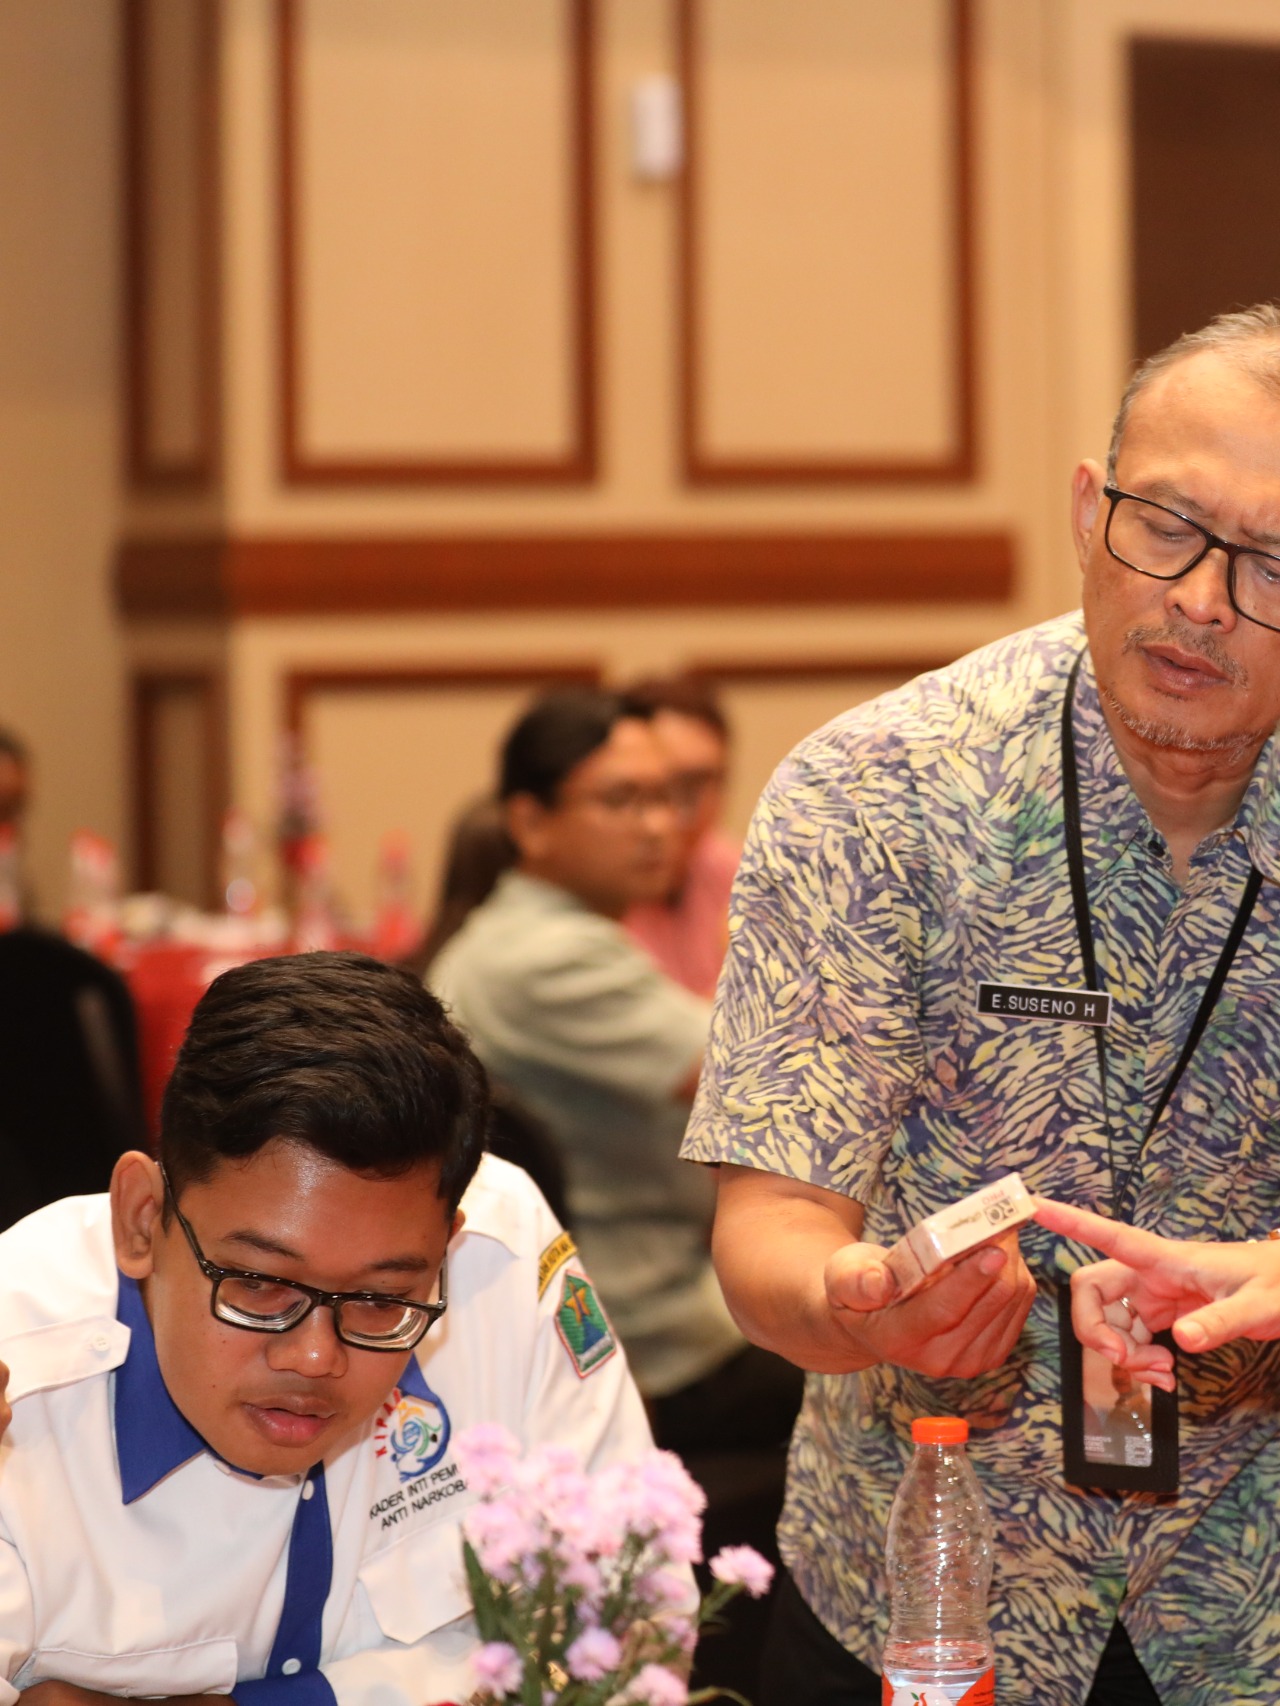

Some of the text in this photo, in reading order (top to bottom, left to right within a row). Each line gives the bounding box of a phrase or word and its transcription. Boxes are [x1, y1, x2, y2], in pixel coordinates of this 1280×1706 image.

[1084, 1003, 1096, 1018] H
[369, 1491, 404, 1519] KADER
[407, 1477, 429, 1498] INTI
[381, 1507, 408, 1530] ANTI
